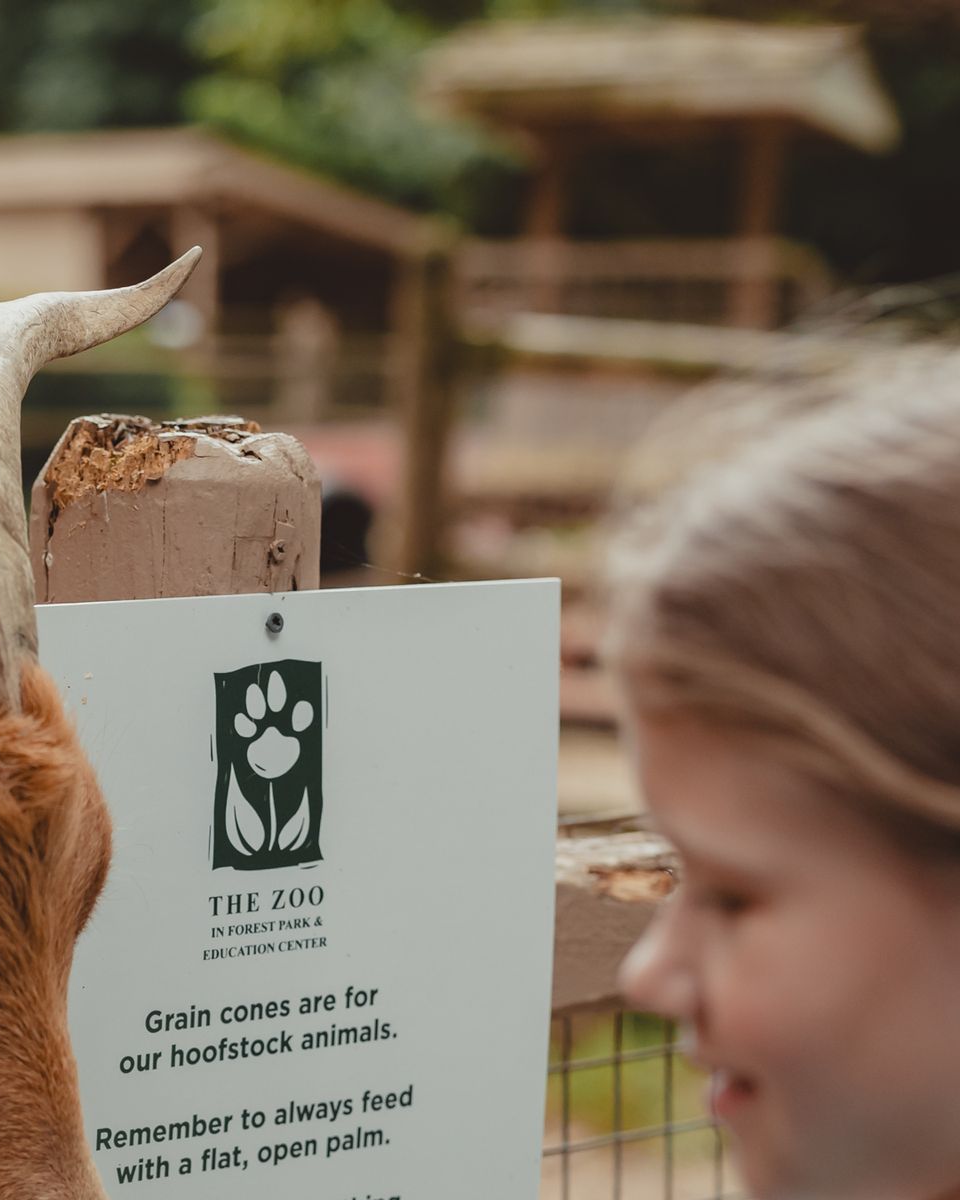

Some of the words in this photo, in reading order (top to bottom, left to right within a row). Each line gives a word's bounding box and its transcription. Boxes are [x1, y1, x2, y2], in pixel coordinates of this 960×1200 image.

[208, 891, 260, 917] THE
[271, 885, 325, 910] ZOO
[202, 943, 275, 961] EDUCATION
[278, 937, 327, 952] CENTER
[211, 927, 224, 939] IN
[227, 921, 274, 937] FOREST
[278, 917, 311, 931] PARK
[313, 916, 323, 927] &
[144, 1004, 211, 1034] Grain
[220, 999, 291, 1025] cones
[298, 994, 336, 1015] are
[344, 985, 379, 1009] for
[119, 1051, 162, 1074] our
[170, 1030, 293, 1068] hoofstock
[300, 1018, 397, 1051] animals.
[95, 1114, 233, 1152] Remember
[240, 1108, 266, 1131] to
[274, 1098, 353, 1126] always
[361, 1084, 413, 1113] feed
[116, 1155, 170, 1185] with
[178, 1157, 192, 1176] a
[200, 1145, 248, 1172] flat,
[257, 1138, 318, 1166] open
[326, 1126, 390, 1158] palm.
